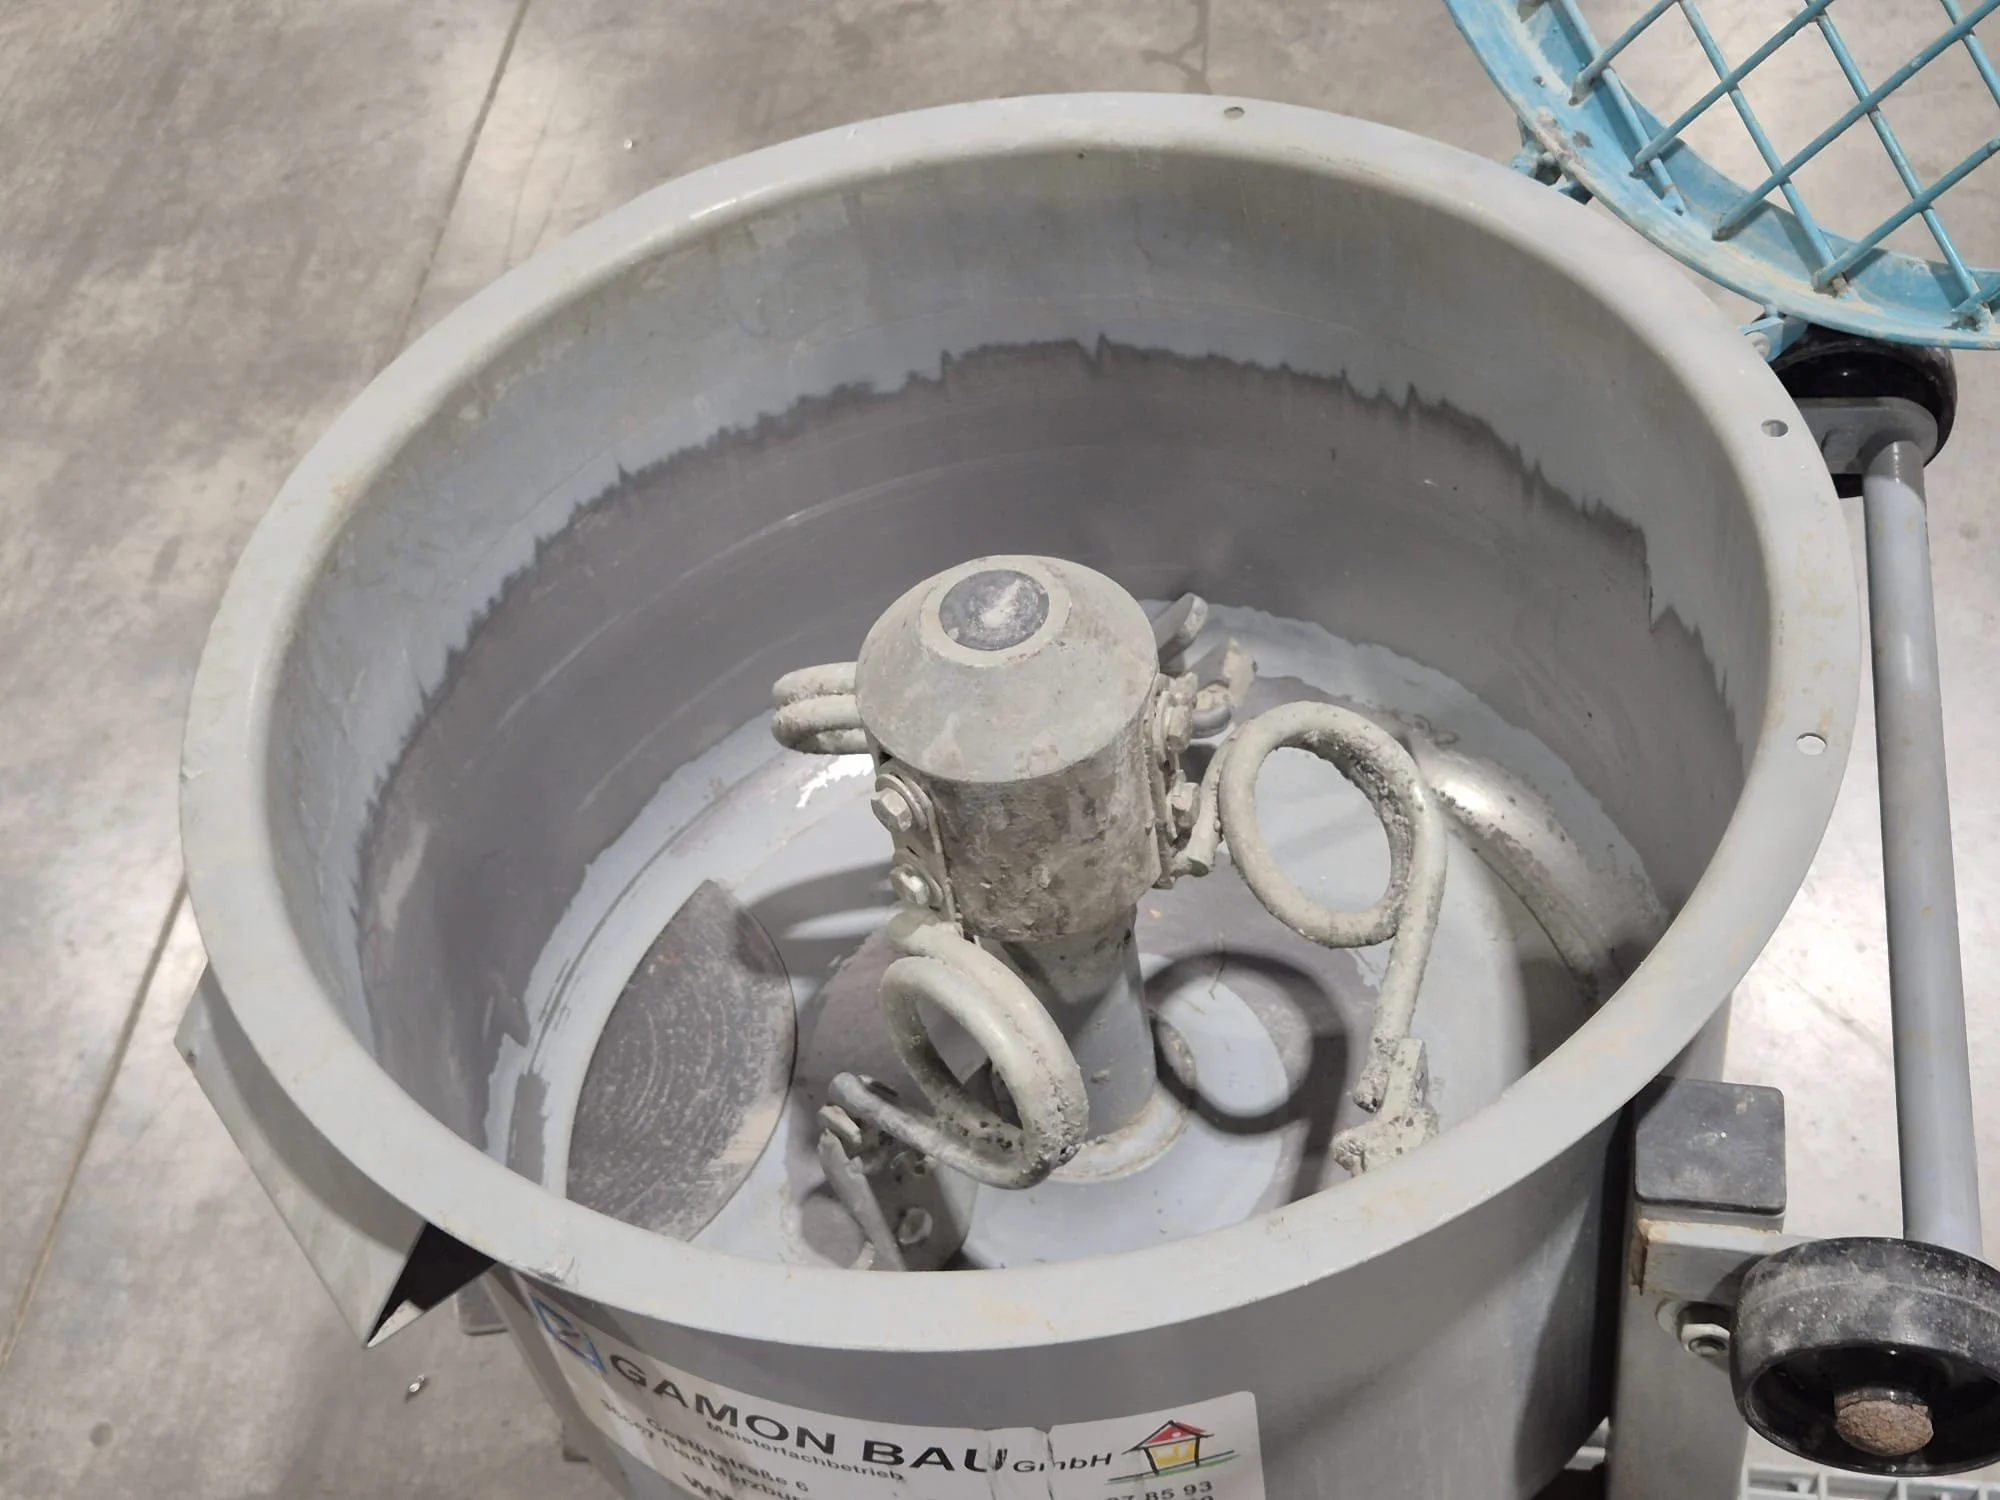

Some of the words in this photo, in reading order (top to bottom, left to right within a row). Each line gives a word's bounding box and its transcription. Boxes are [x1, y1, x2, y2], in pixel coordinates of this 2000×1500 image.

[609, 1353, 836, 1456] GAMON
[862, 1439, 1008, 1473] BAU
[1012, 1452, 1113, 1473] GmbH
[706, 1420, 904, 1482] Meisterfachbetrieb
[795, 1480, 809, 1493] 6
[1182, 1480, 1213, 1497] 93
